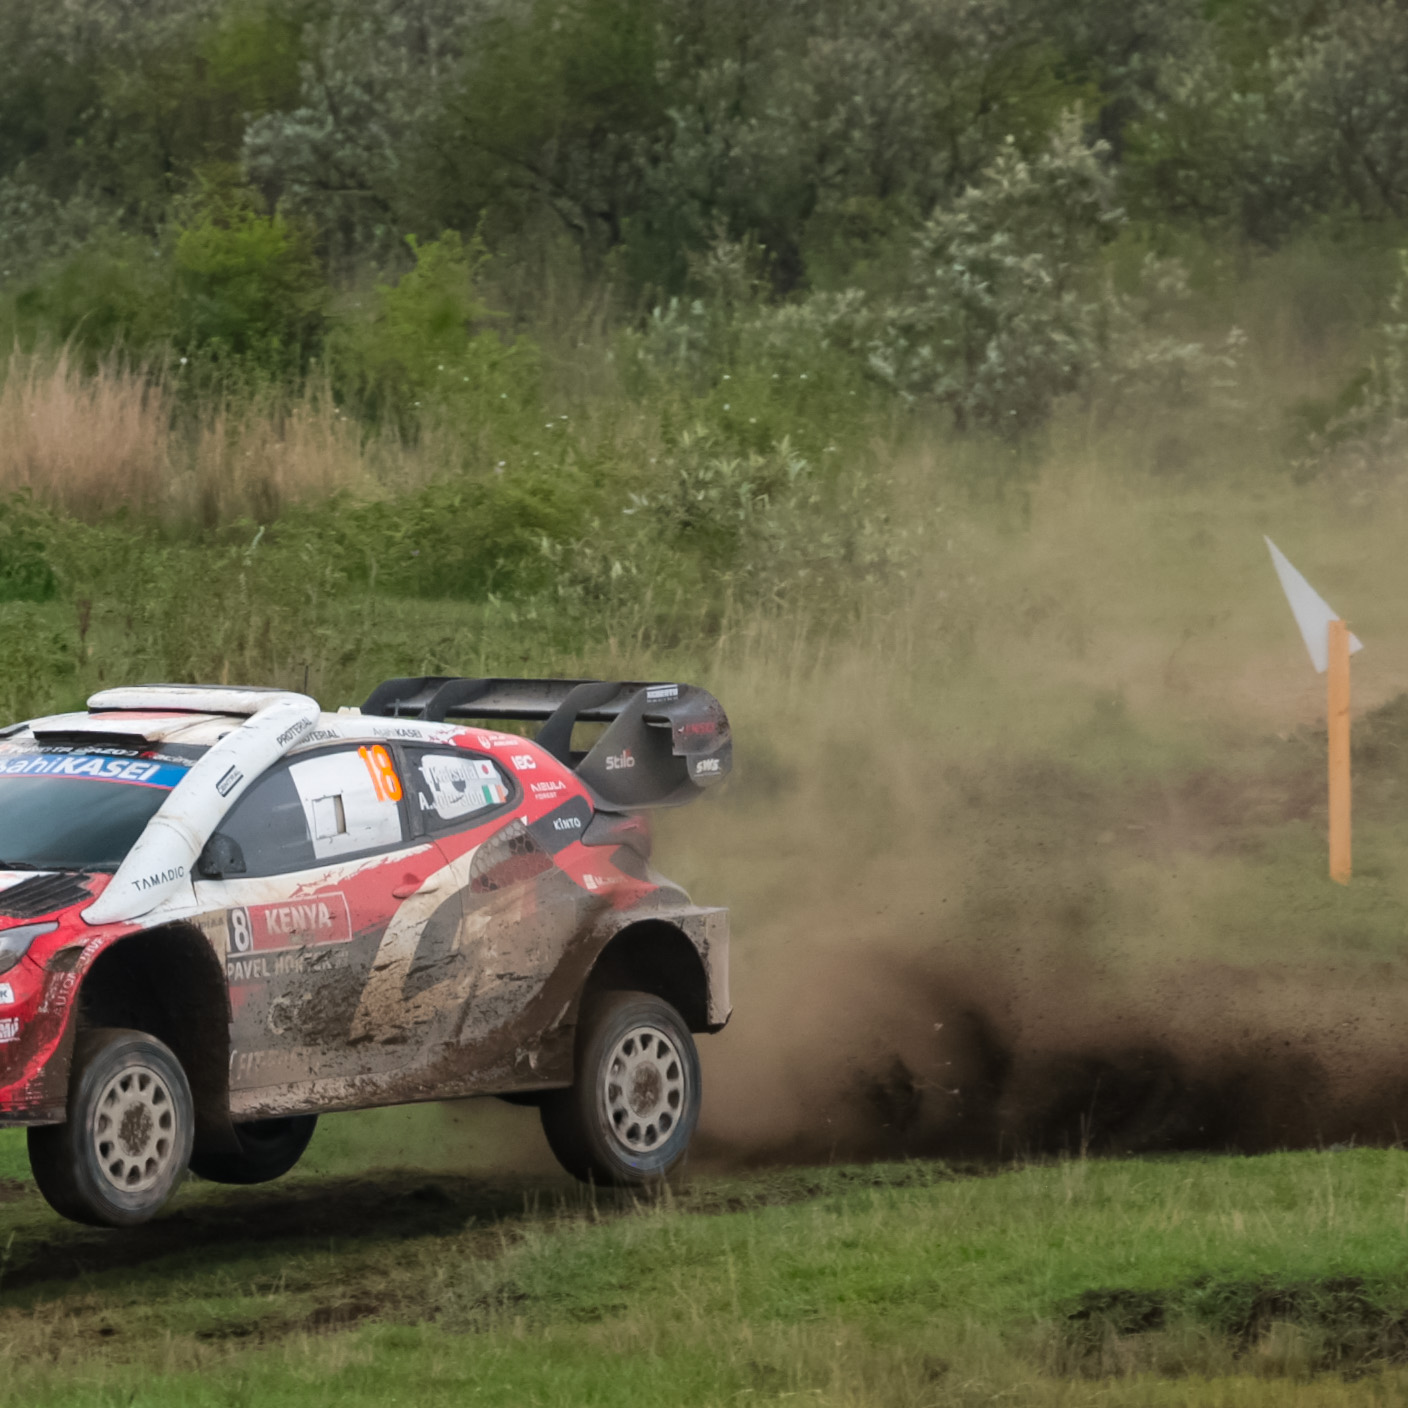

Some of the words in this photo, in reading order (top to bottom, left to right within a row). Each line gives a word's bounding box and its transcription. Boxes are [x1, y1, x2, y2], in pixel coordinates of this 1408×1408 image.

[276, 716, 312, 747] PROTERIAL
[357, 744, 403, 802] 18
[605, 749, 635, 770] Stilo
[131, 865, 185, 891] TAMADIC
[264, 902, 333, 935] KENYA
[227, 958, 271, 981] PAVEL
